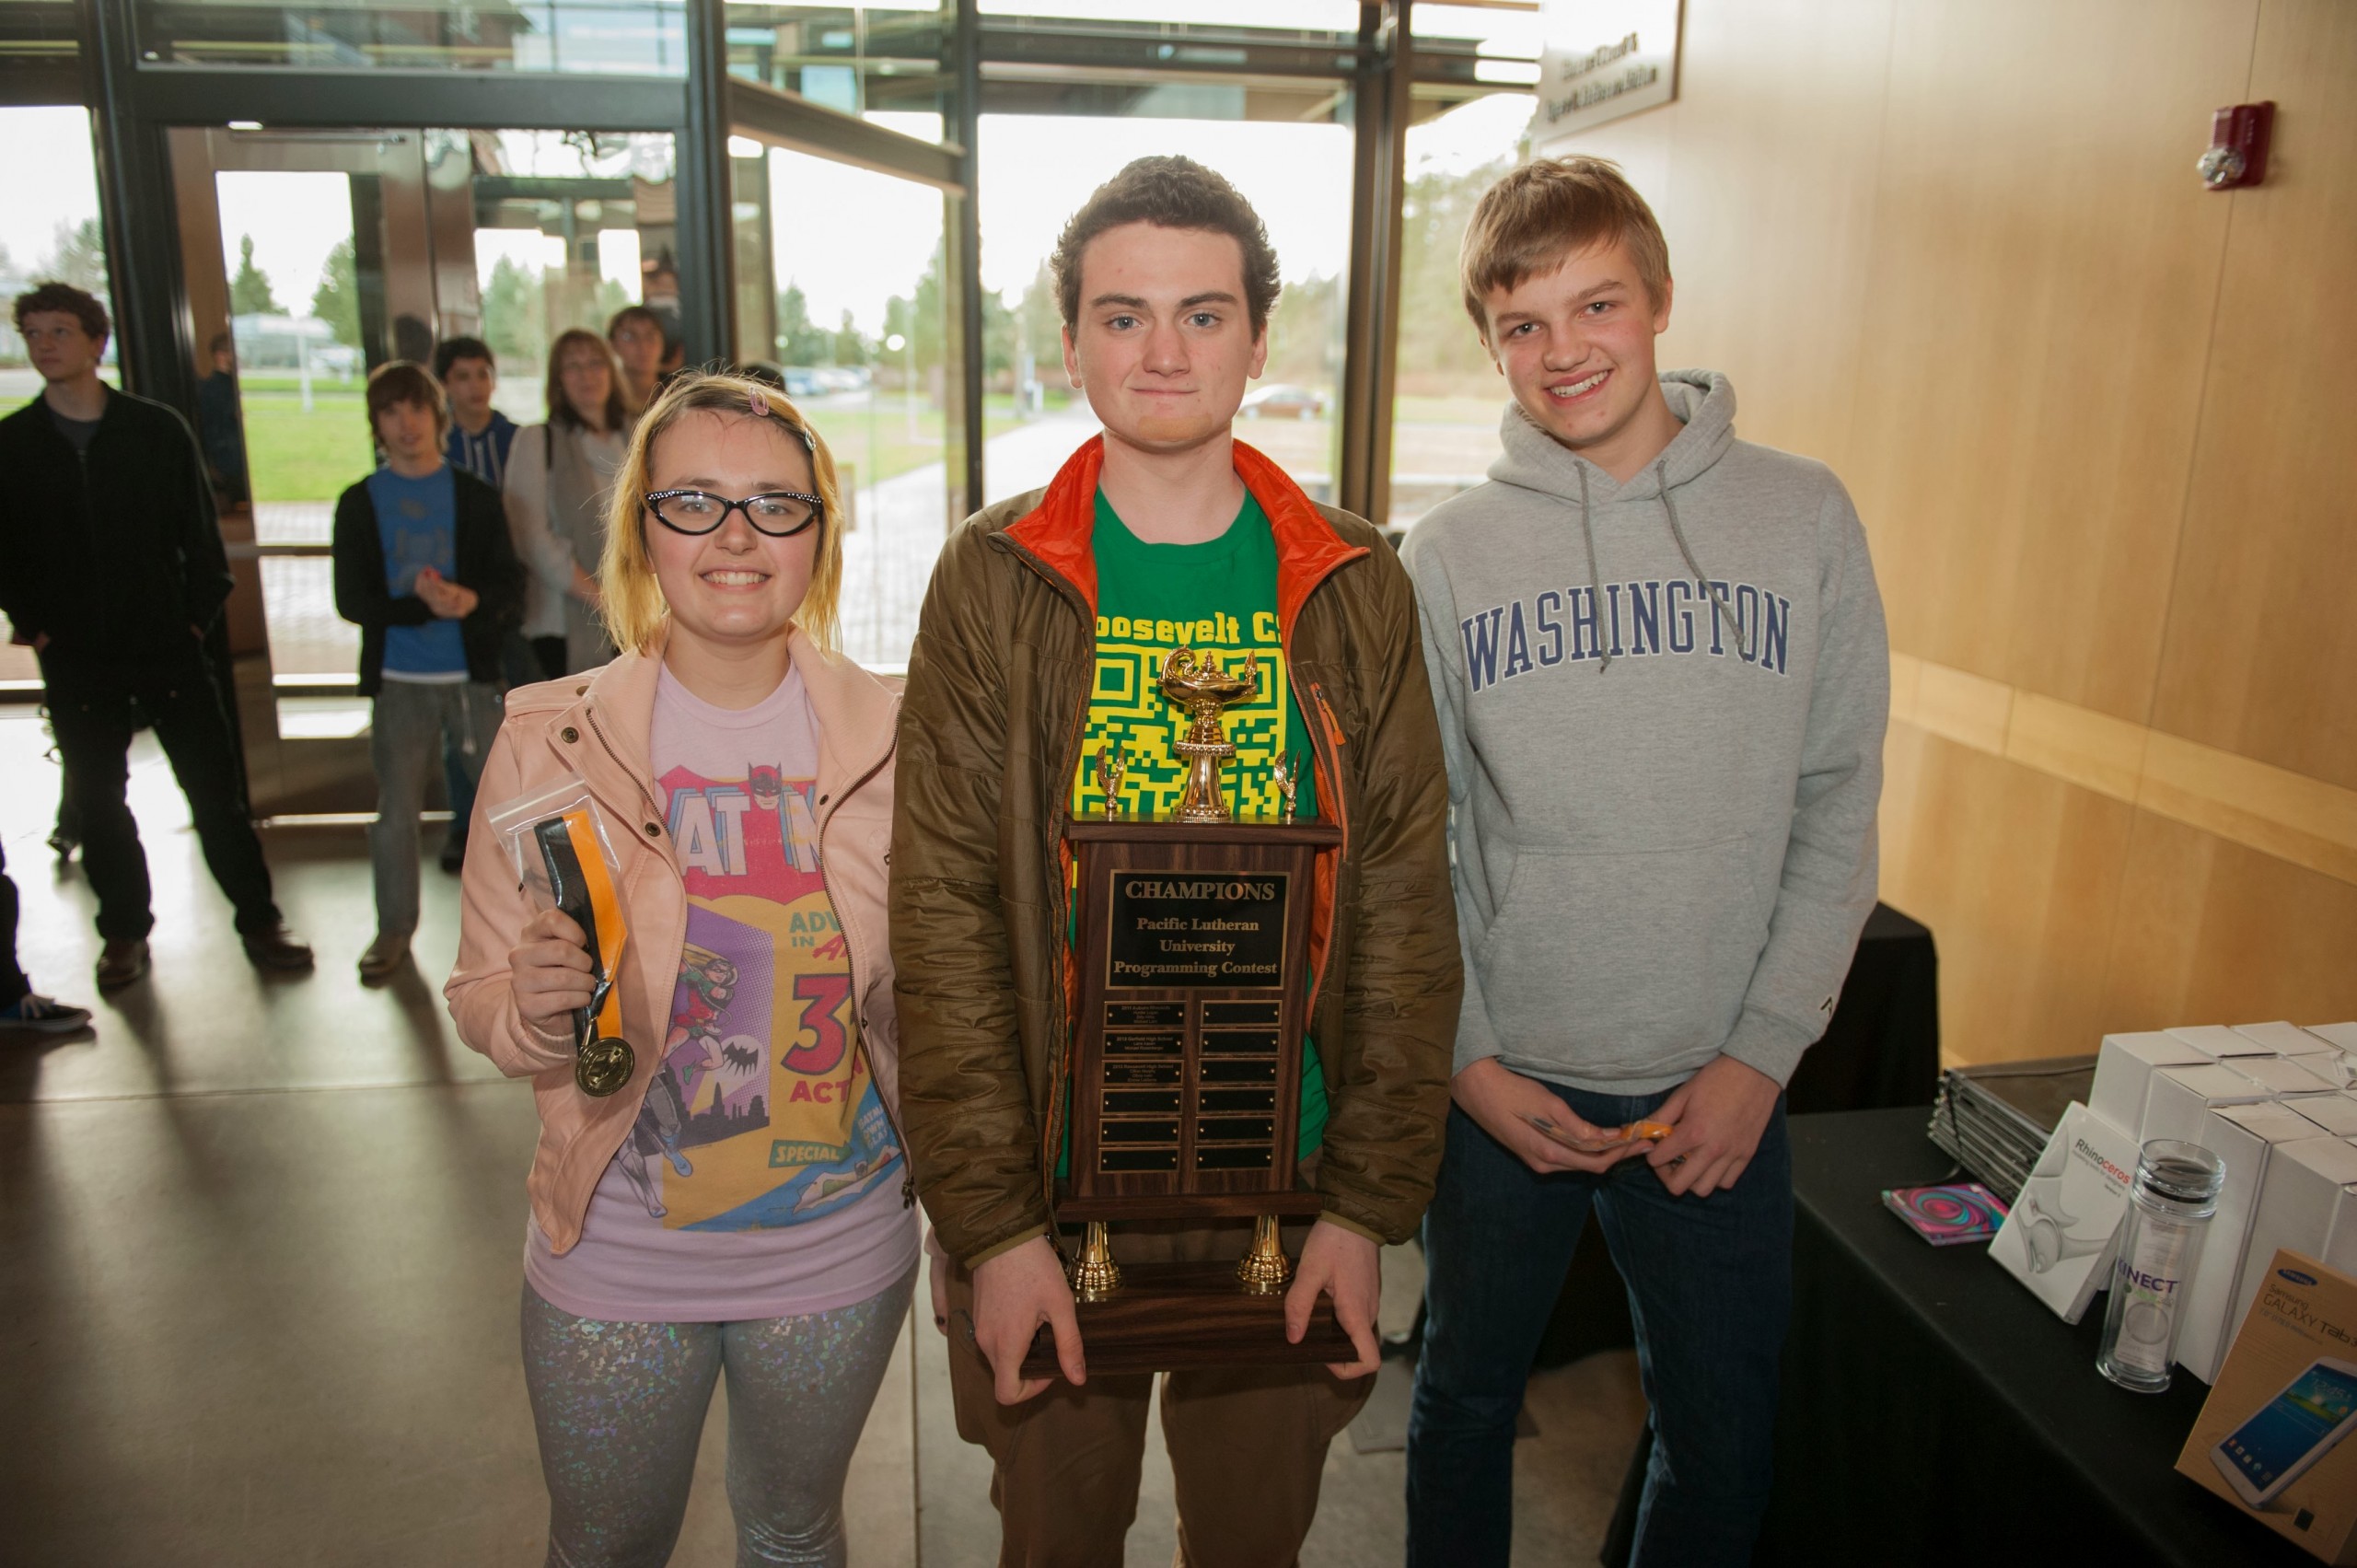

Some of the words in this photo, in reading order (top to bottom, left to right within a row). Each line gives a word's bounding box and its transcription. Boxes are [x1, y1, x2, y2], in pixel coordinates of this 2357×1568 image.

[1096, 611, 1240, 645] oosevelt
[1252, 611, 1282, 643] C
[1461, 578, 1791, 693] WASHINGTON
[1125, 880, 1275, 900] CHAMPIONS
[789, 911, 841, 934] ADV
[1136, 917, 1188, 931] Pacific
[1191, 918, 1260, 931] Lutheran
[791, 935, 816, 948] IN
[1159, 939, 1236, 957] University
[1113, 960, 1218, 977] Programming
[1221, 961, 1278, 974] Contest
[781, 972, 853, 1075] 3
[789, 1079, 851, 1104] ACT
[775, 1144, 841, 1164] SPECIAL
[2075, 1138, 2131, 1184] Rhinoceros
[2269, 1283, 2309, 1310] Samsung
[2263, 1294, 2318, 1327] GALAXY
[2320, 1320, 2351, 1344] Tab
